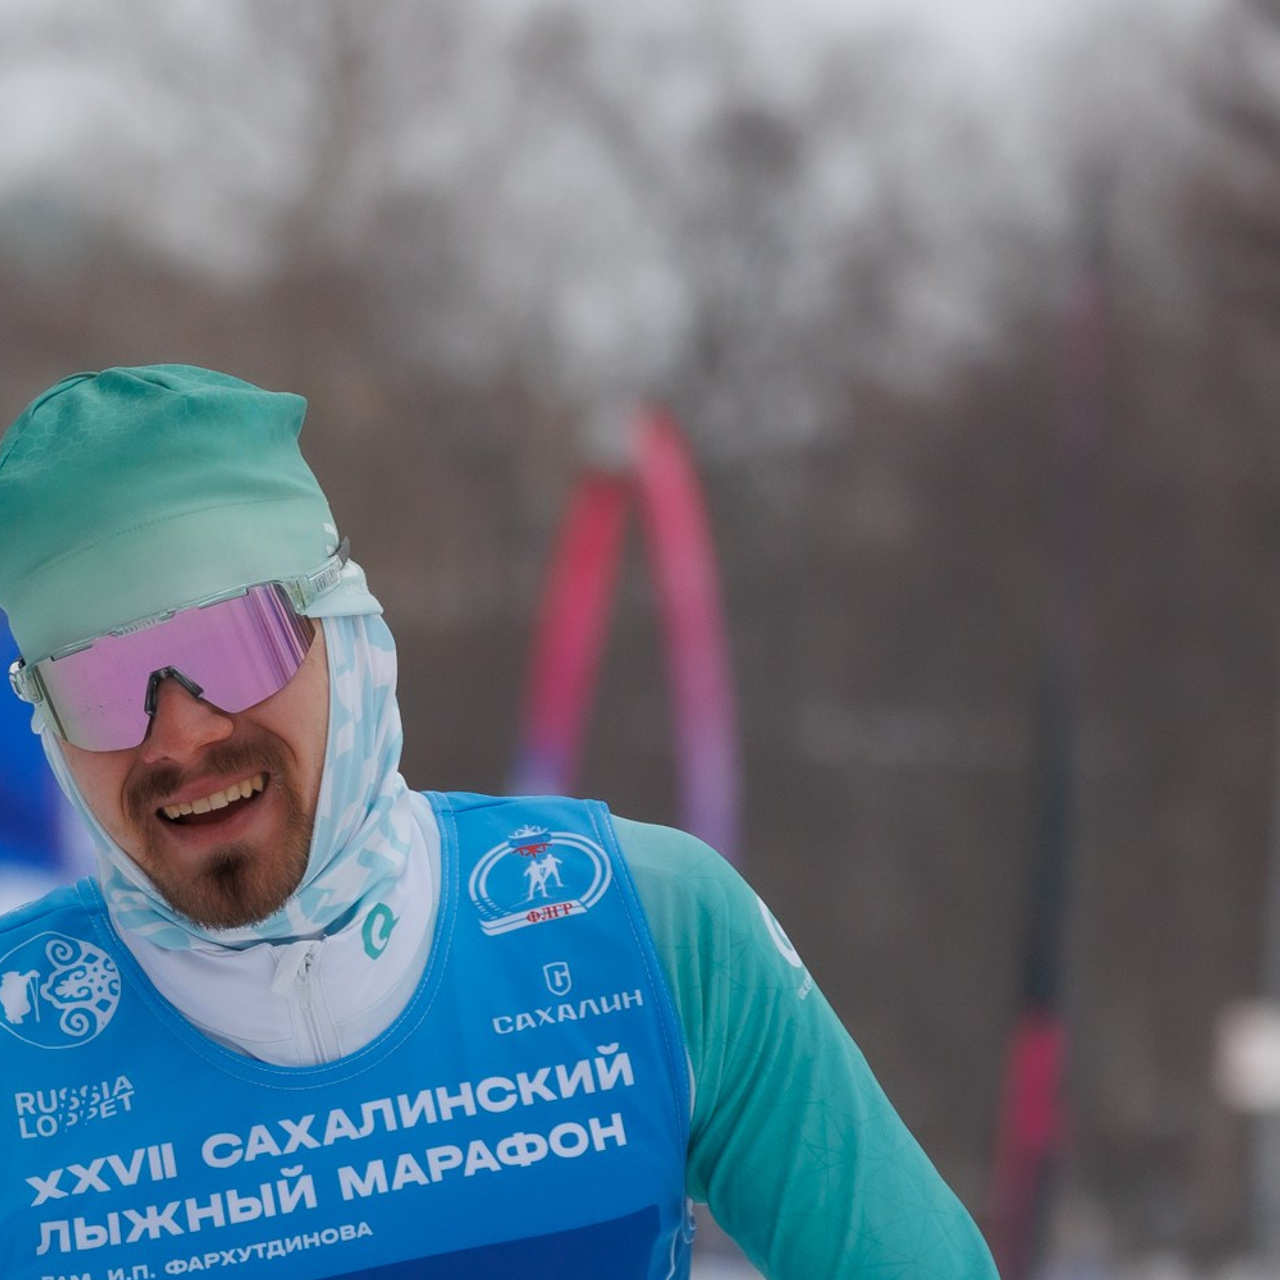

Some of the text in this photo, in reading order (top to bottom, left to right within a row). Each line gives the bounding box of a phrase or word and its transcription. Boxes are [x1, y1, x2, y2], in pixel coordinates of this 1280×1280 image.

[526, 902, 573, 923] ФЛГР
[492, 989, 644, 1035] САХАЛИН
[14, 1075, 134, 1116] RUSSIA
[25, 1042, 635, 1207] XXVII САХАЛИНСКИЙ
[36, 1113, 628, 1256] ЛЫЖНЫЙ МАРАФОН
[164, 1222, 374, 1275] ФАРХУТДИНОВА
